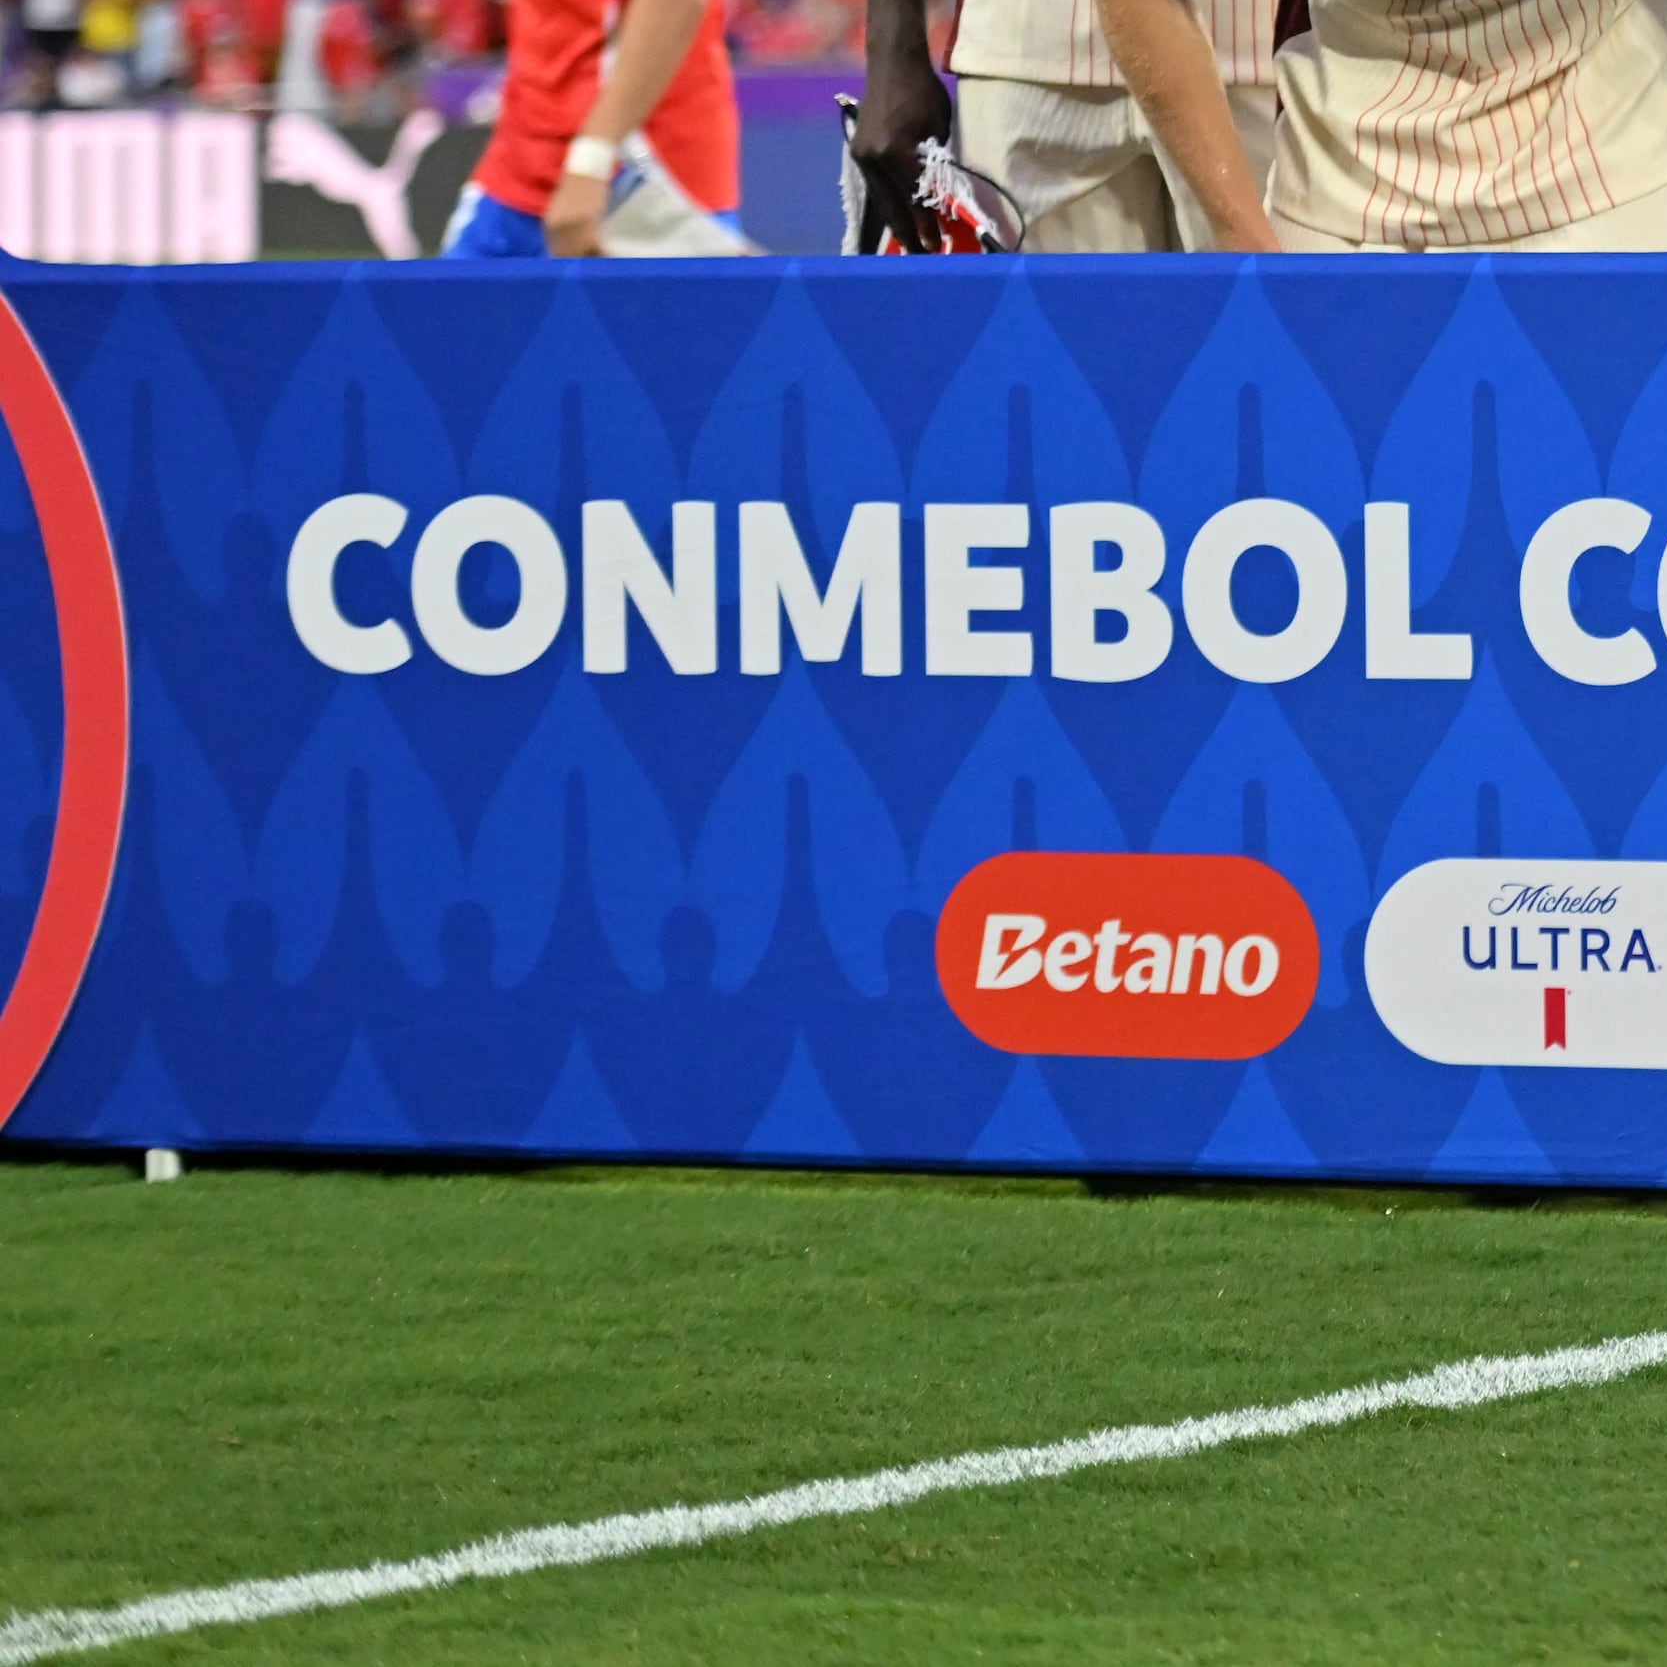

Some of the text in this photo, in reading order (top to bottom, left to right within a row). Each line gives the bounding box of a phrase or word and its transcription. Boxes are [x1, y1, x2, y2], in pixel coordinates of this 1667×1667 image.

[287, 494, 1473, 683] CONMEBOL
[1487, 883, 1623, 916] Michelob
[976, 913, 1279, 997] Betano
[1462, 925, 1657, 974] ULTRA
